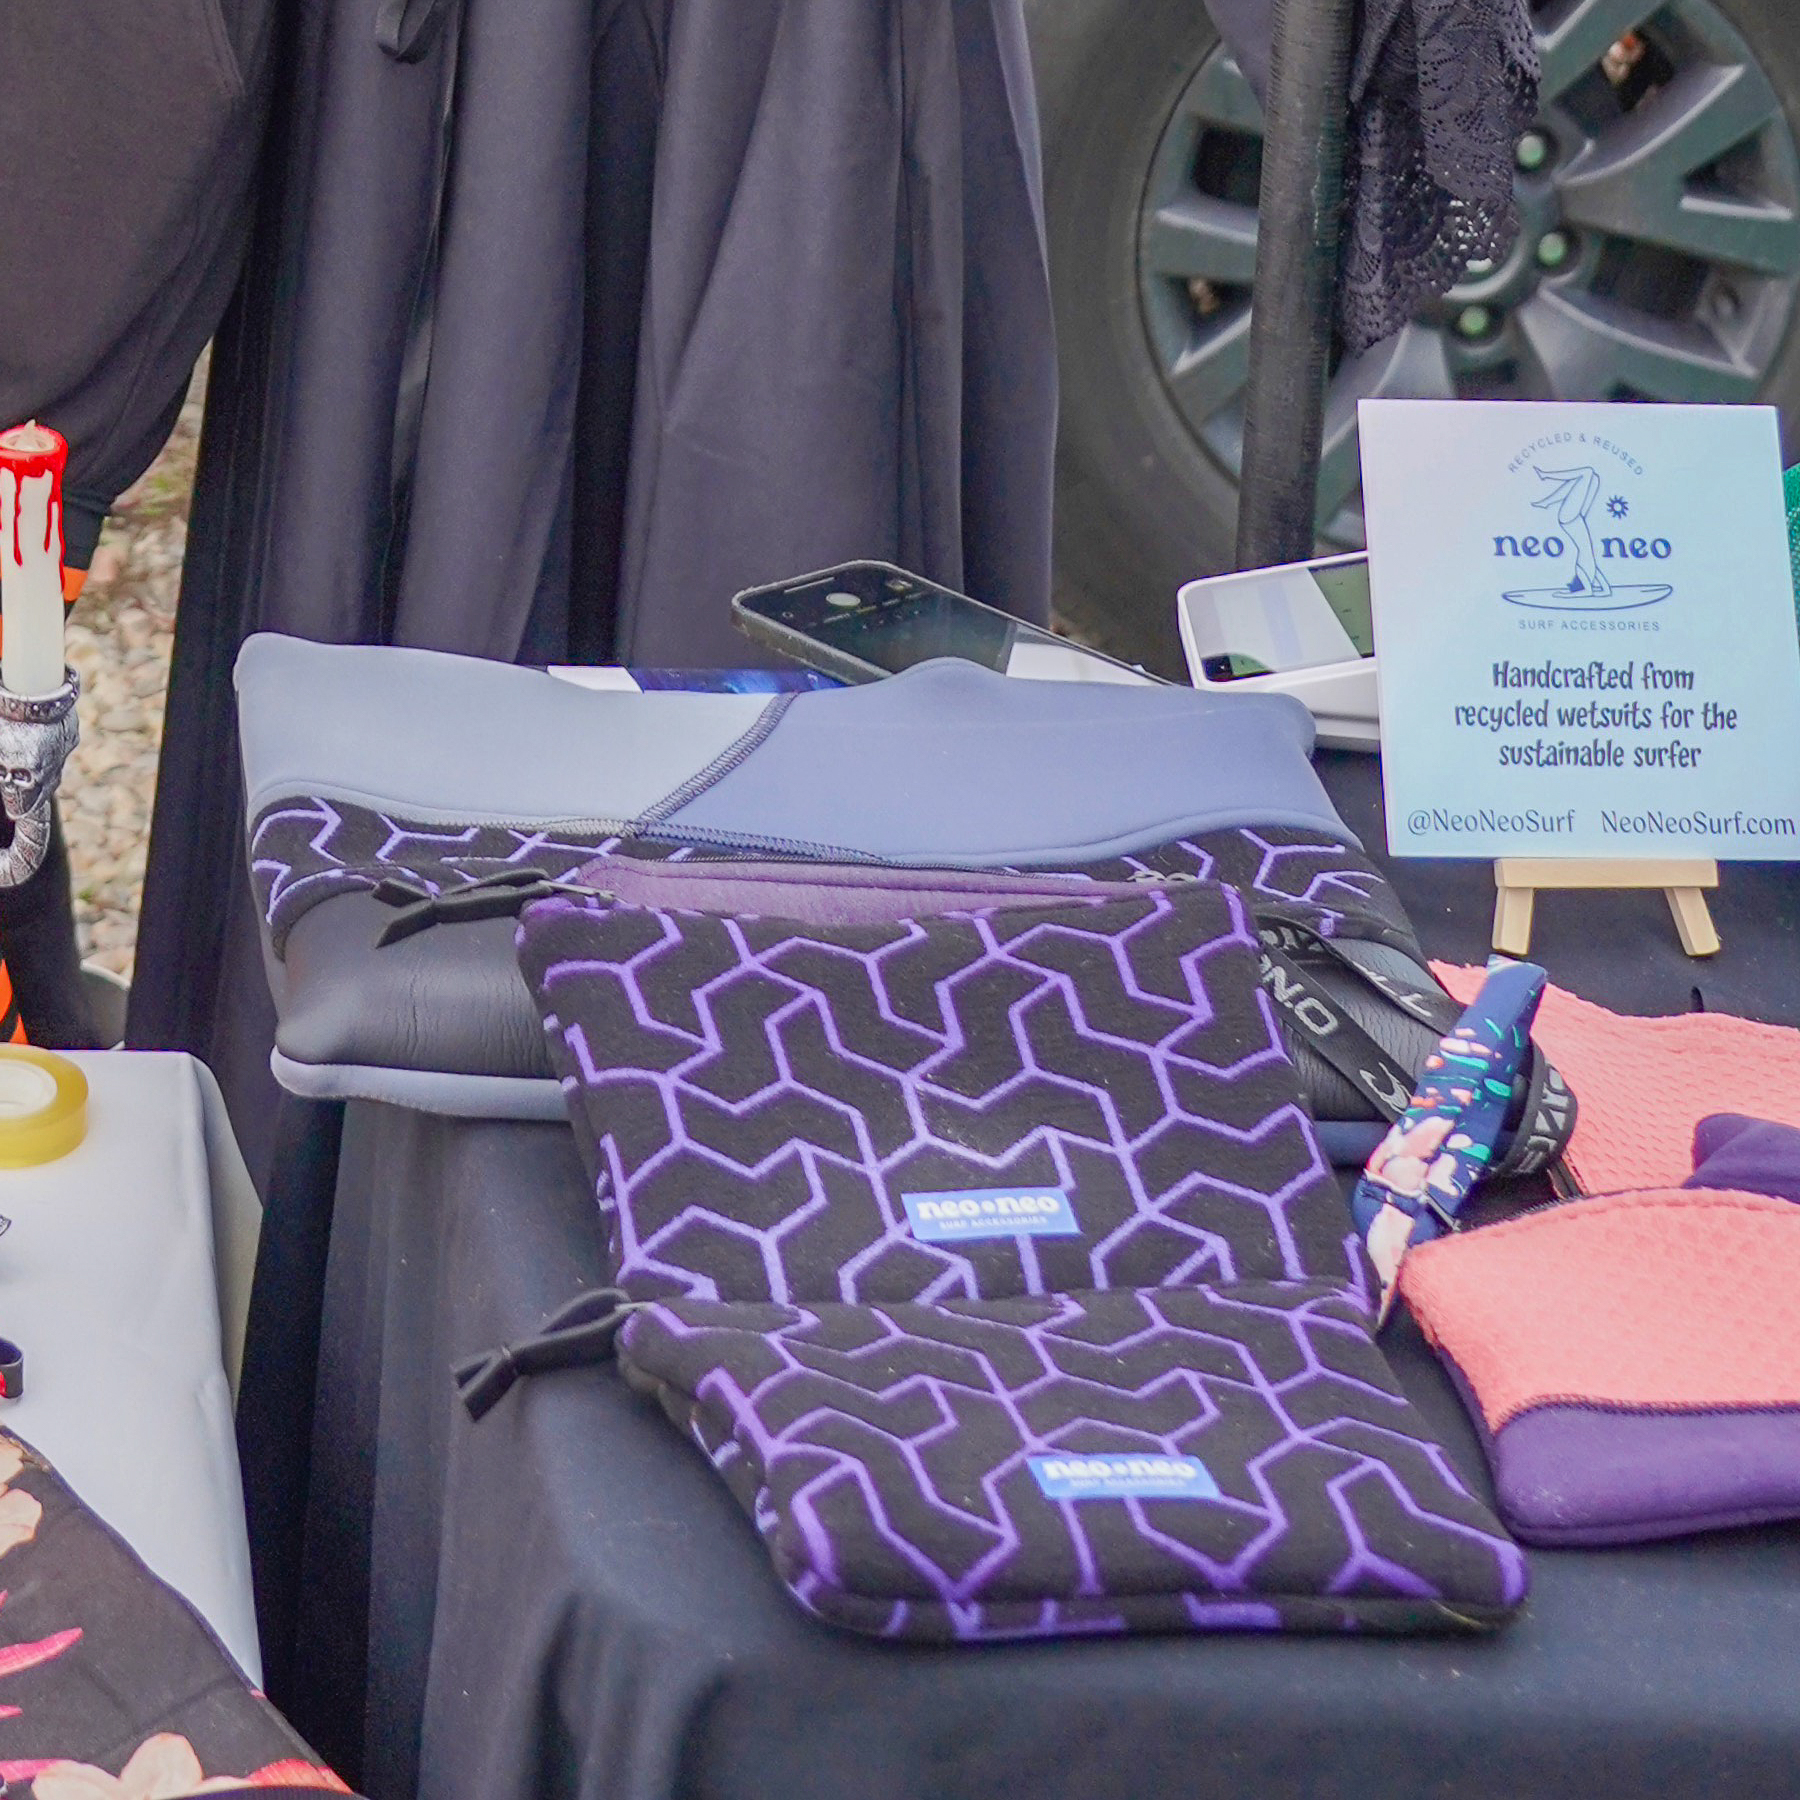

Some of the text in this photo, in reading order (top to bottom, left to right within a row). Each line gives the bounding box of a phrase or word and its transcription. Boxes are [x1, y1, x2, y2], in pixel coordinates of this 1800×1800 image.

[1507, 432, 1644, 476] RECYCLED & REUSED
[1493, 535, 1673, 560] neo neo
[1518, 619, 1662, 632] SURF ACCESSORIES
[1492, 659, 1695, 691] Handcrafted from
[1454, 698, 1738, 733] recycled wetsuits for the
[1498, 737, 1702, 769] sustainable surfer
[1406, 808, 1797, 837] @NeoNeoSurf NeoNeoSurf.com
[916, 1196, 1061, 1221] neo neo
